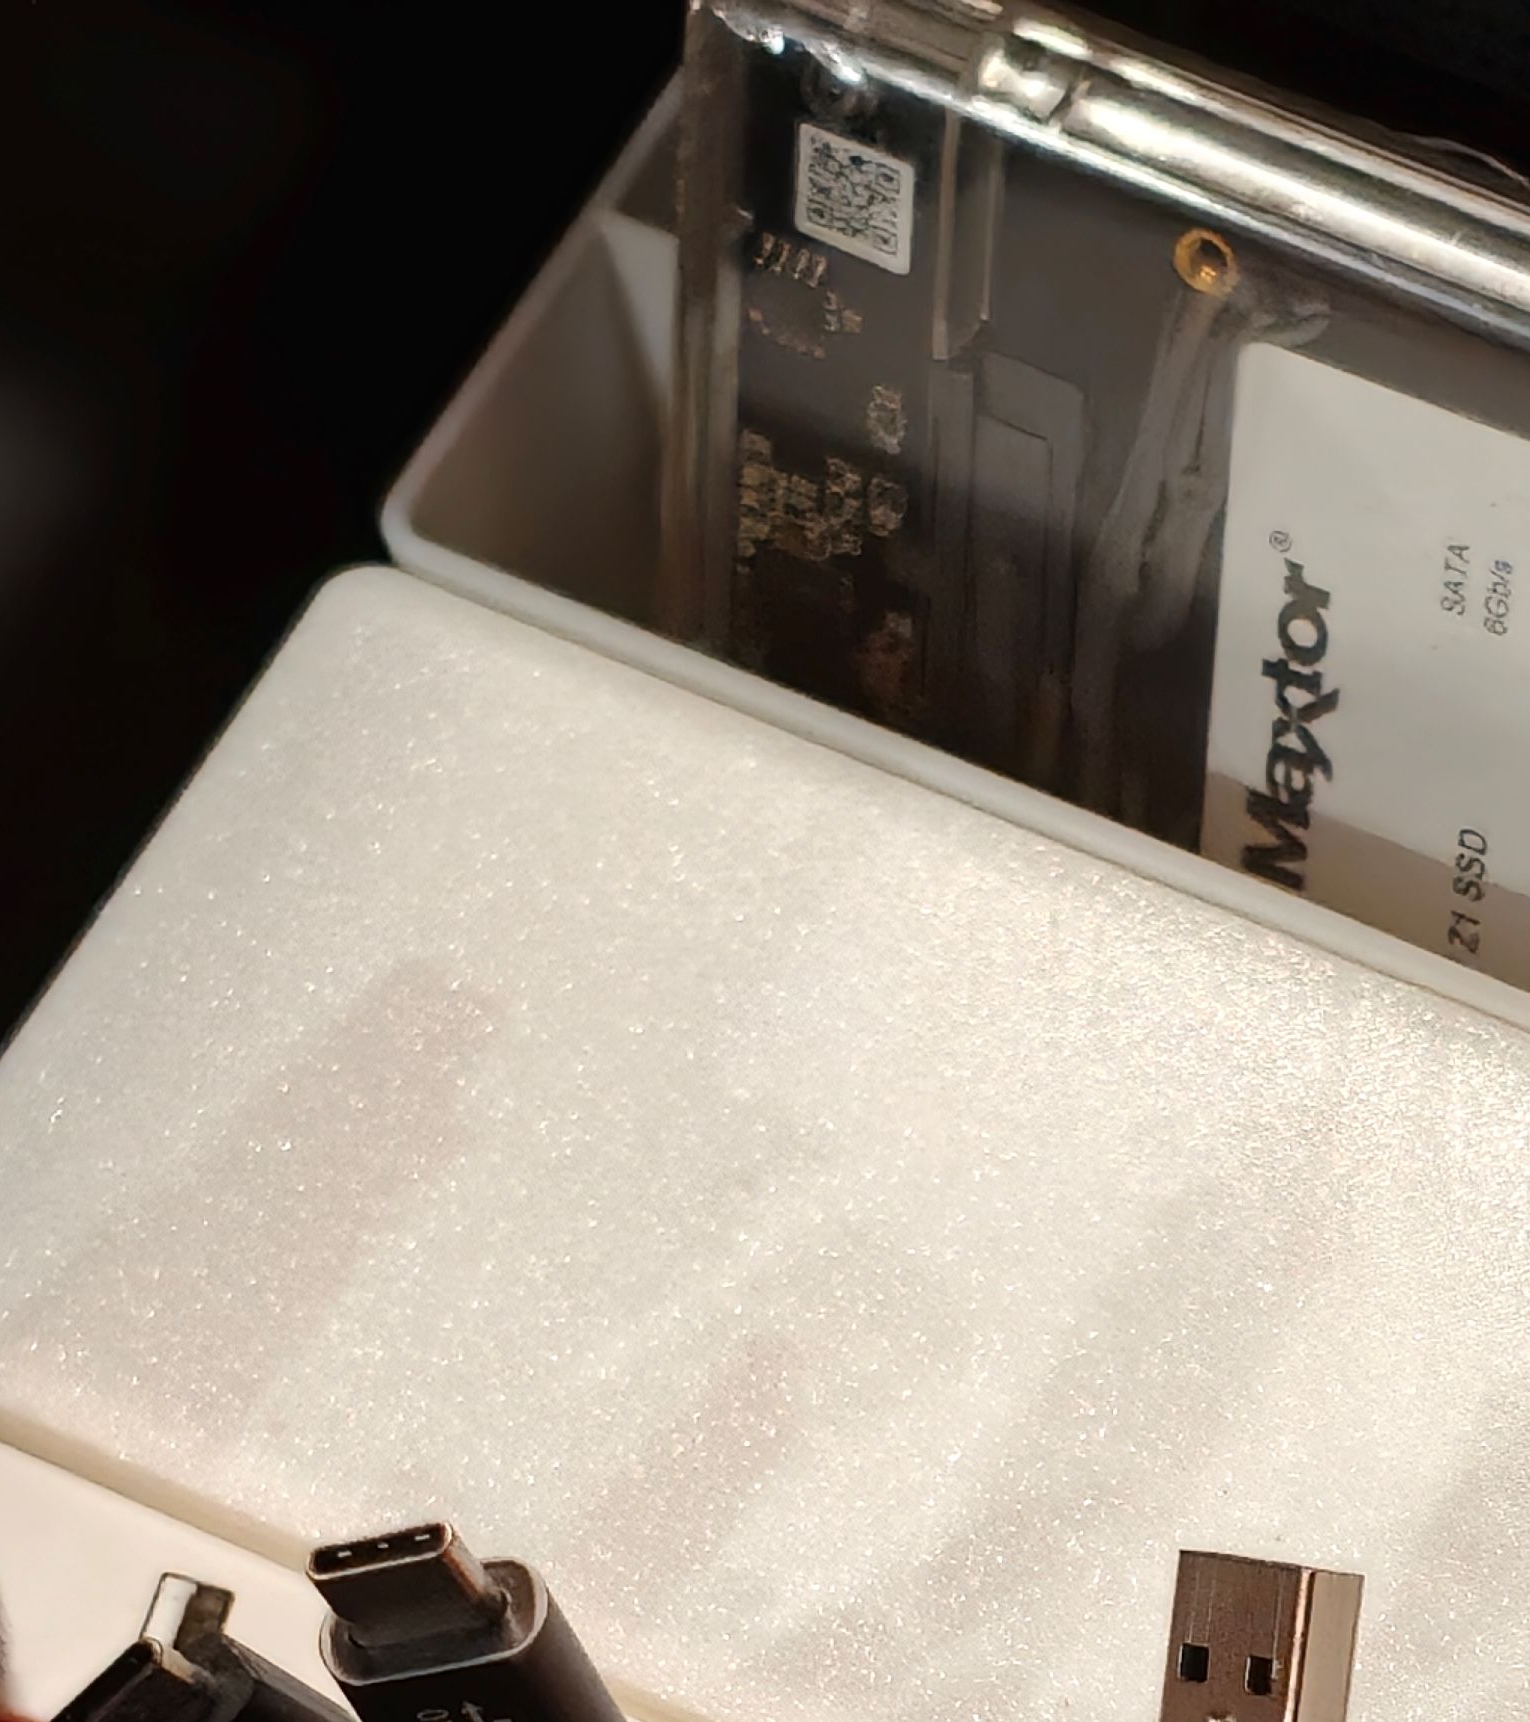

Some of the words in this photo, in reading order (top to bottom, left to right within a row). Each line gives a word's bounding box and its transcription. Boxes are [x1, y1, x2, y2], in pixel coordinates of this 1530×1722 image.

[1441, 543, 1470, 617] SATA
[1483, 560, 1514, 637] 6Gb/s
[1240, 558, 1340, 891] Maxtor
[1453, 828, 1488, 902] SSD
